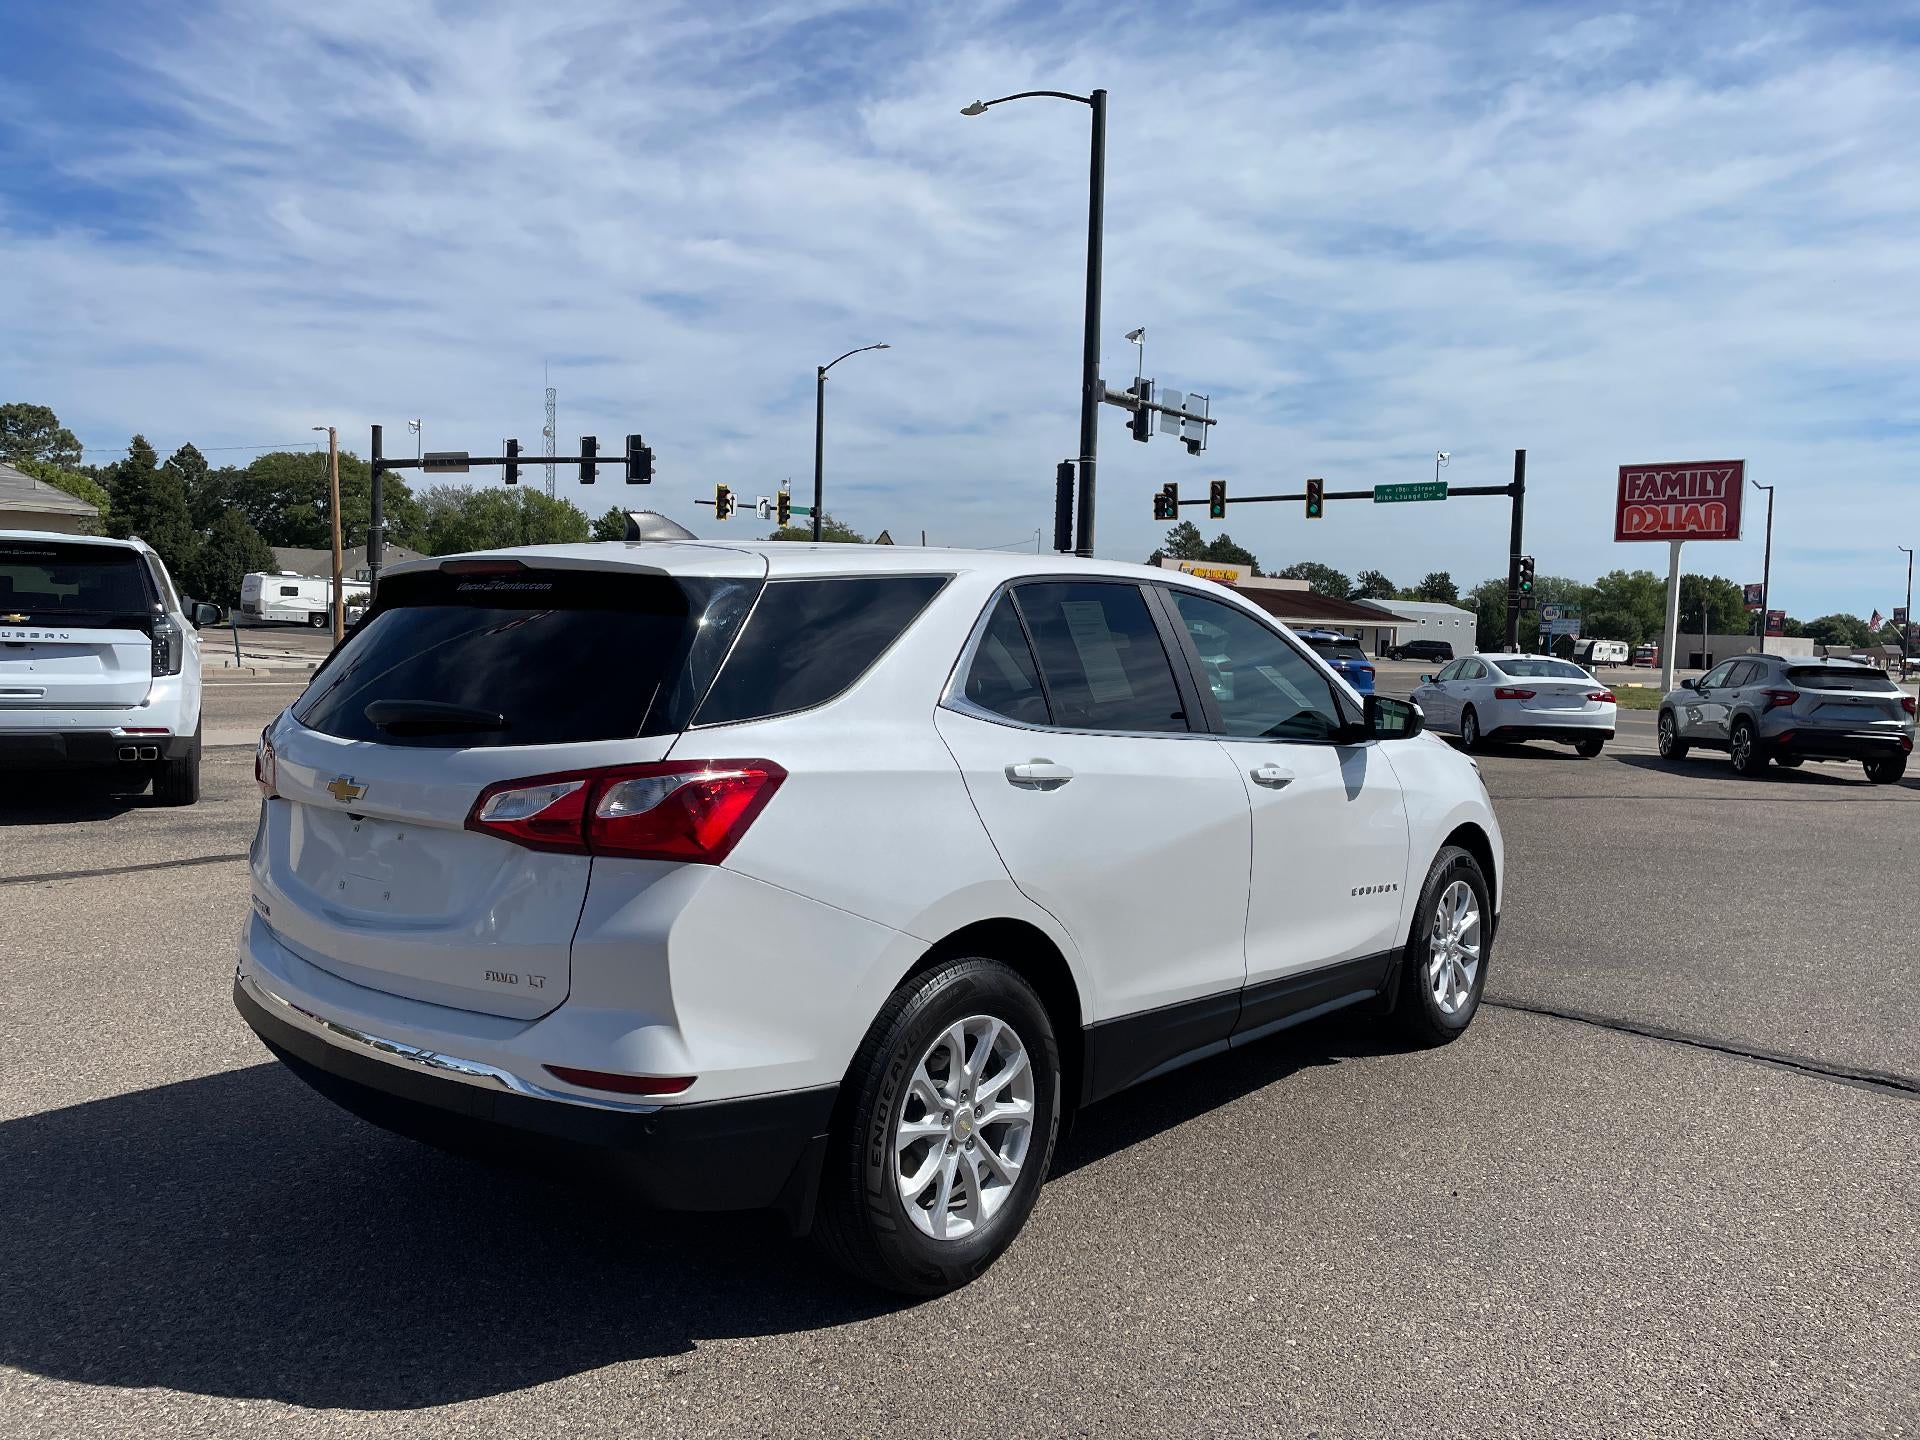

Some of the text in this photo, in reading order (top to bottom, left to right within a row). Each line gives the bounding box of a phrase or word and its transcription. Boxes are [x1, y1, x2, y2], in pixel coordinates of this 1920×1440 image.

[1625, 469, 1735, 501] FAMILY
[1623, 502, 1726, 534] DOLLAR
[1351, 883, 1398, 896] EQUINOX
[526, 974, 546, 988] LT
[871, 1014, 928, 1169] ENDEAV
